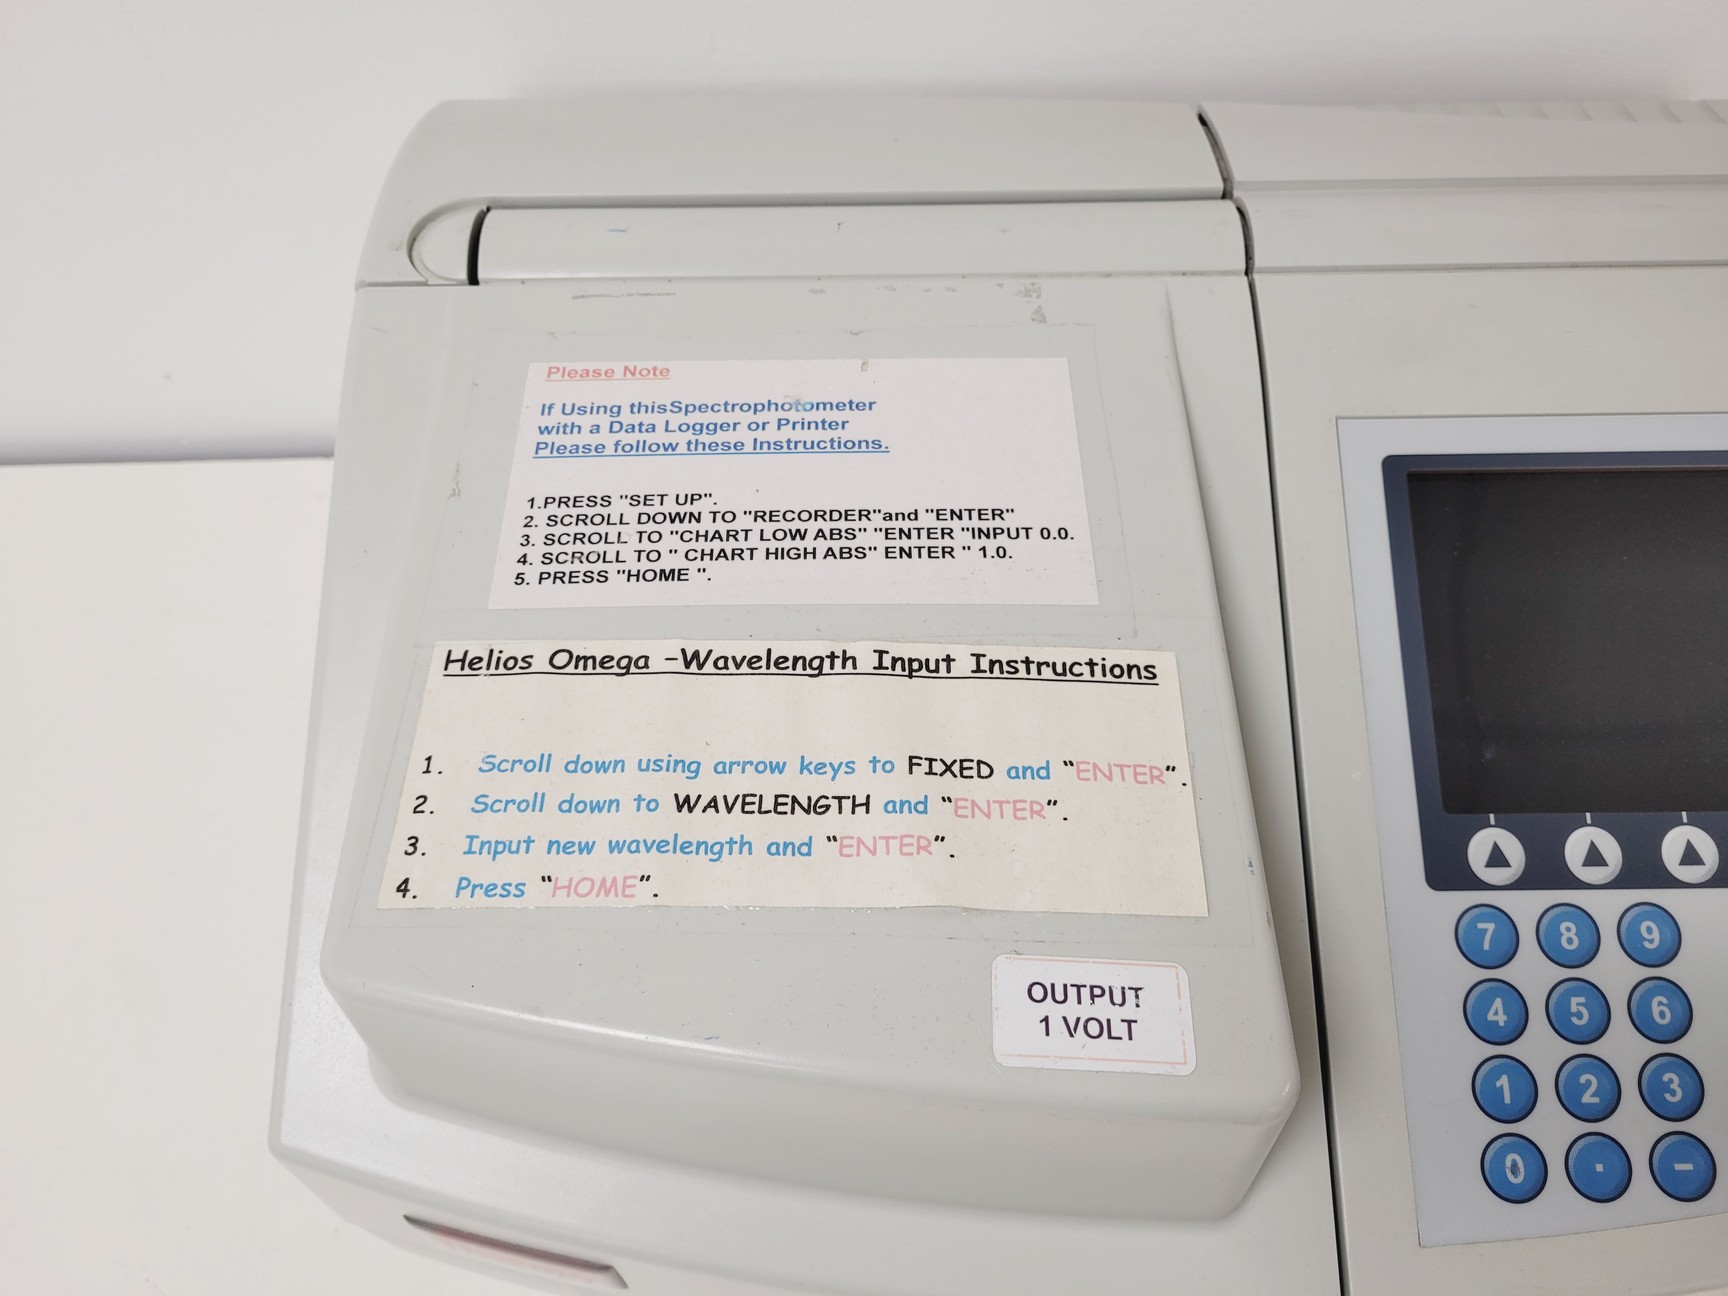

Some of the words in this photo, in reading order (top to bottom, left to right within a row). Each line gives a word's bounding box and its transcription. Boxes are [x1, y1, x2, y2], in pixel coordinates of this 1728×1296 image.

[546, 365, 615, 380] Please
[622, 364, 671, 379] Note
[540, 402, 555, 417] If
[561, 401, 622, 418] Using
[629, 399, 877, 417] thisSpectrophotometer
[538, 421, 582, 436] with
[589, 423, 601, 434] a
[608, 420, 656, 434] Data
[664, 419, 741, 436] Logger
[747, 420, 770, 432] or
[776, 417, 849, 431] Printer
[534, 441, 606, 455] Please
[613, 439, 680, 454] follow
[686, 438, 745, 452] these
[752, 436, 889, 451] Instructions.
[619, 493, 669, 507] "SET
[675, 493, 717, 506] UP".
[523, 515, 539, 528] 2.
[546, 513, 630, 527] SCROLL
[637, 511, 702, 525] DOWN
[709, 510, 737, 524] TO
[925, 508, 1015, 521] "ENTER"
[519, 534, 536, 547] 3.
[543, 531, 628, 546] SCROLL
[636, 530, 663, 544] TO
[670, 529, 753, 543] "CHART
[759, 528, 808, 542] LOW
[813, 527, 867, 541] ABS"
[874, 527, 955, 541] "ENTER
[961, 526, 1033, 540] "INPUT
[1040, 527, 1075, 540] 0.0.
[516, 553, 533, 566] 4.
[540, 550, 627, 565] SCROLL
[633, 549, 662, 563] TO
[684, 547, 759, 562] CHART
[765, 546, 817, 560] HIGH
[822, 546, 878, 560] ABS"
[884, 546, 956, 559] ENTER
[978, 545, 1013, 559] 1.0.
[514, 572, 530, 586] 5.
[538, 570, 609, 585] PRESS
[617, 568, 690, 583] "HOME
[444, 648, 534, 672] Helios
[549, 648, 650, 676] Omega
[872, 649, 956, 679] Input
[970, 652, 1158, 680] Instructions
[421, 755, 443, 774] 1.
[478, 753, 552, 773] Scroll
[563, 754, 625, 774] down
[637, 754, 701, 780] using
[713, 758, 787, 775] arrow
[799, 755, 856, 782] keys
[868, 755, 895, 774] to
[908, 755, 994, 779] FIXED
[1006, 759, 1051, 780] and
[412, 794, 434, 814] 2.
[470, 792, 546, 814] Scroll
[557, 793, 620, 813] down
[633, 794, 660, 813] to
[673, 793, 871, 815] WAVELENGTH
[883, 795, 928, 815] and
[404, 835, 426, 856] 3.
[462, 834, 535, 861] Input
[546, 839, 597, 855] new
[608, 833, 753, 862] wavelength
[766, 835, 813, 857] and
[395, 877, 418, 899] 4.
[455, 876, 526, 898] Press
[1476, 922, 1496, 950] 7
[1559, 921, 1580, 950] 8
[1640, 920, 1660, 949] 9
[1027, 981, 1144, 1008] OUTPUT
[1486, 997, 1507, 1027] 4
[1569, 996, 1590, 1026] 5
[1651, 995, 1672, 1025] 6
[1039, 1015, 1050, 1037] 1
[1061, 1015, 1138, 1041] VOLT
[1495, 1074, 1512, 1104] 1
[1579, 1074, 1600, 1104] 2
[1661, 1072, 1683, 1103] 3
[1503, 1152, 1525, 1183] 0
